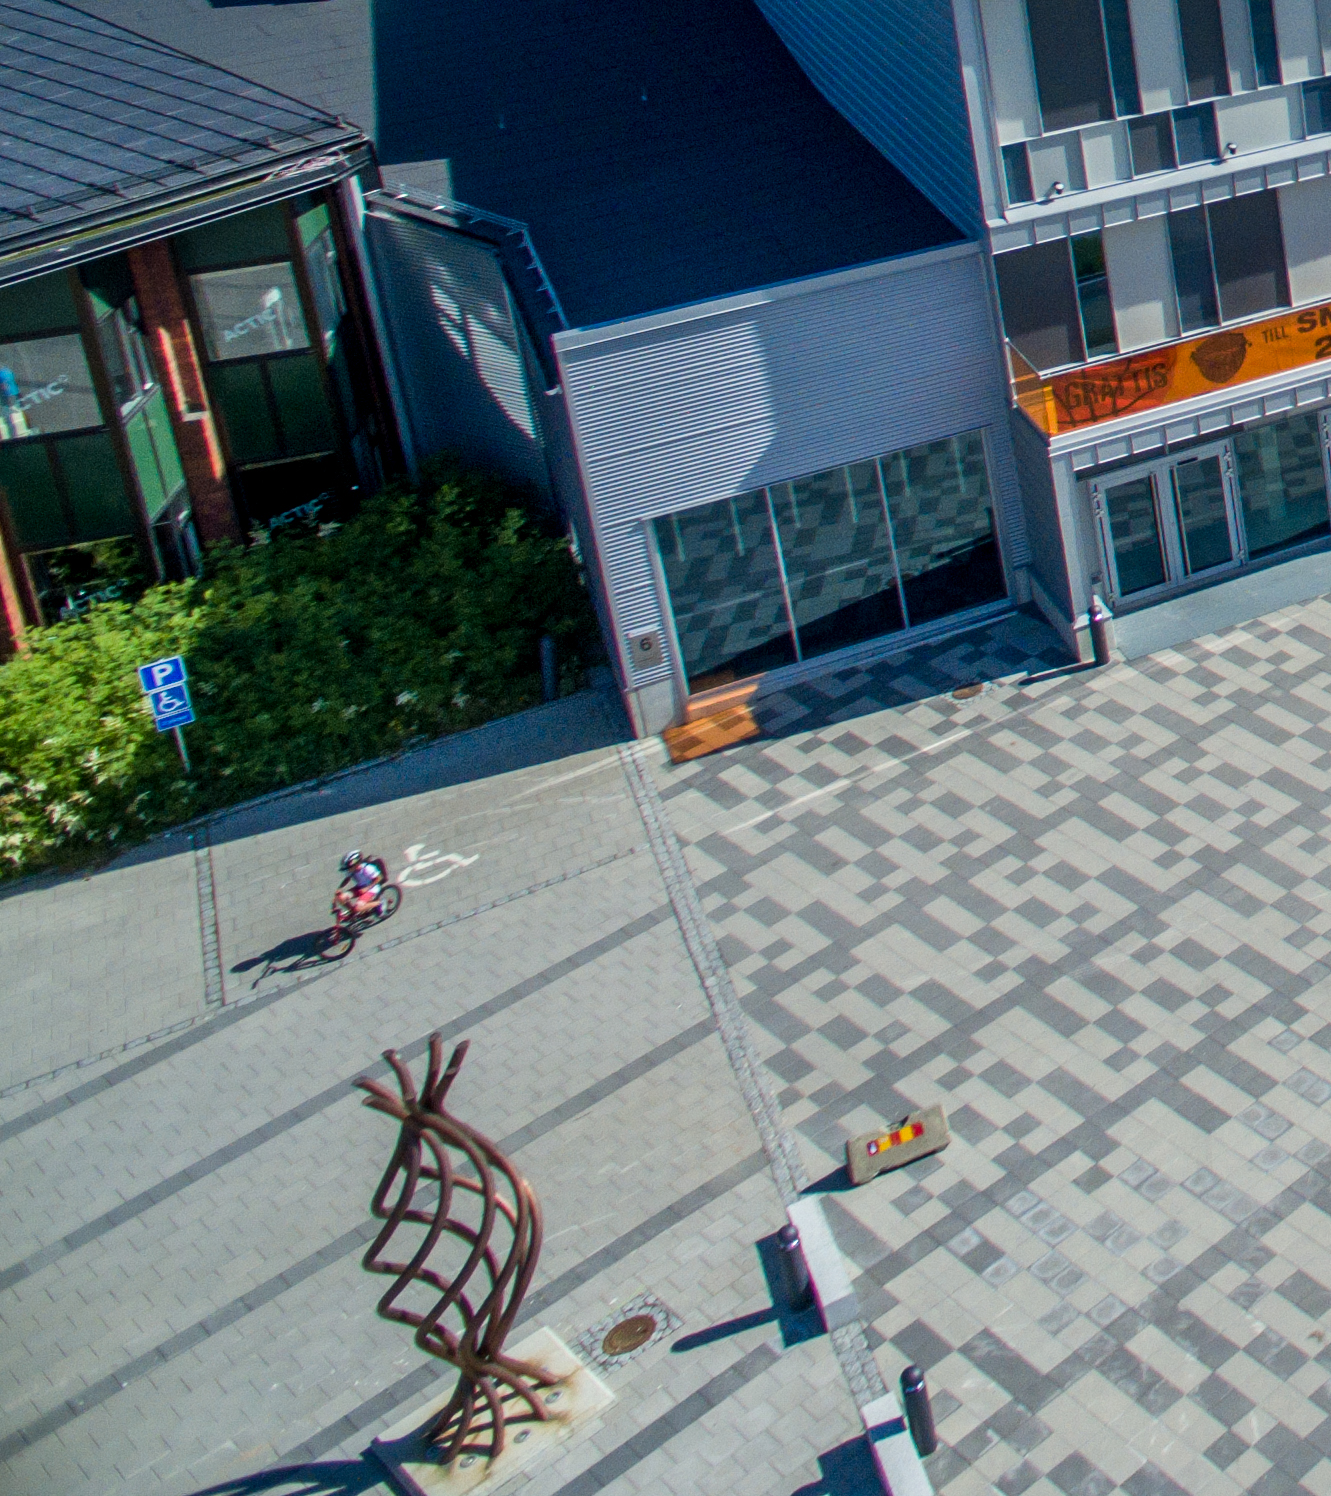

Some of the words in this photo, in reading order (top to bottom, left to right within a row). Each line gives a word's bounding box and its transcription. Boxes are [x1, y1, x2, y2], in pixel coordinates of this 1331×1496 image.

[1064, 362, 1168, 410] GRATTIS
[1262, 326, 1289, 344] TILL
[640, 637, 653, 651] 6
[151, 663, 174, 688] P
